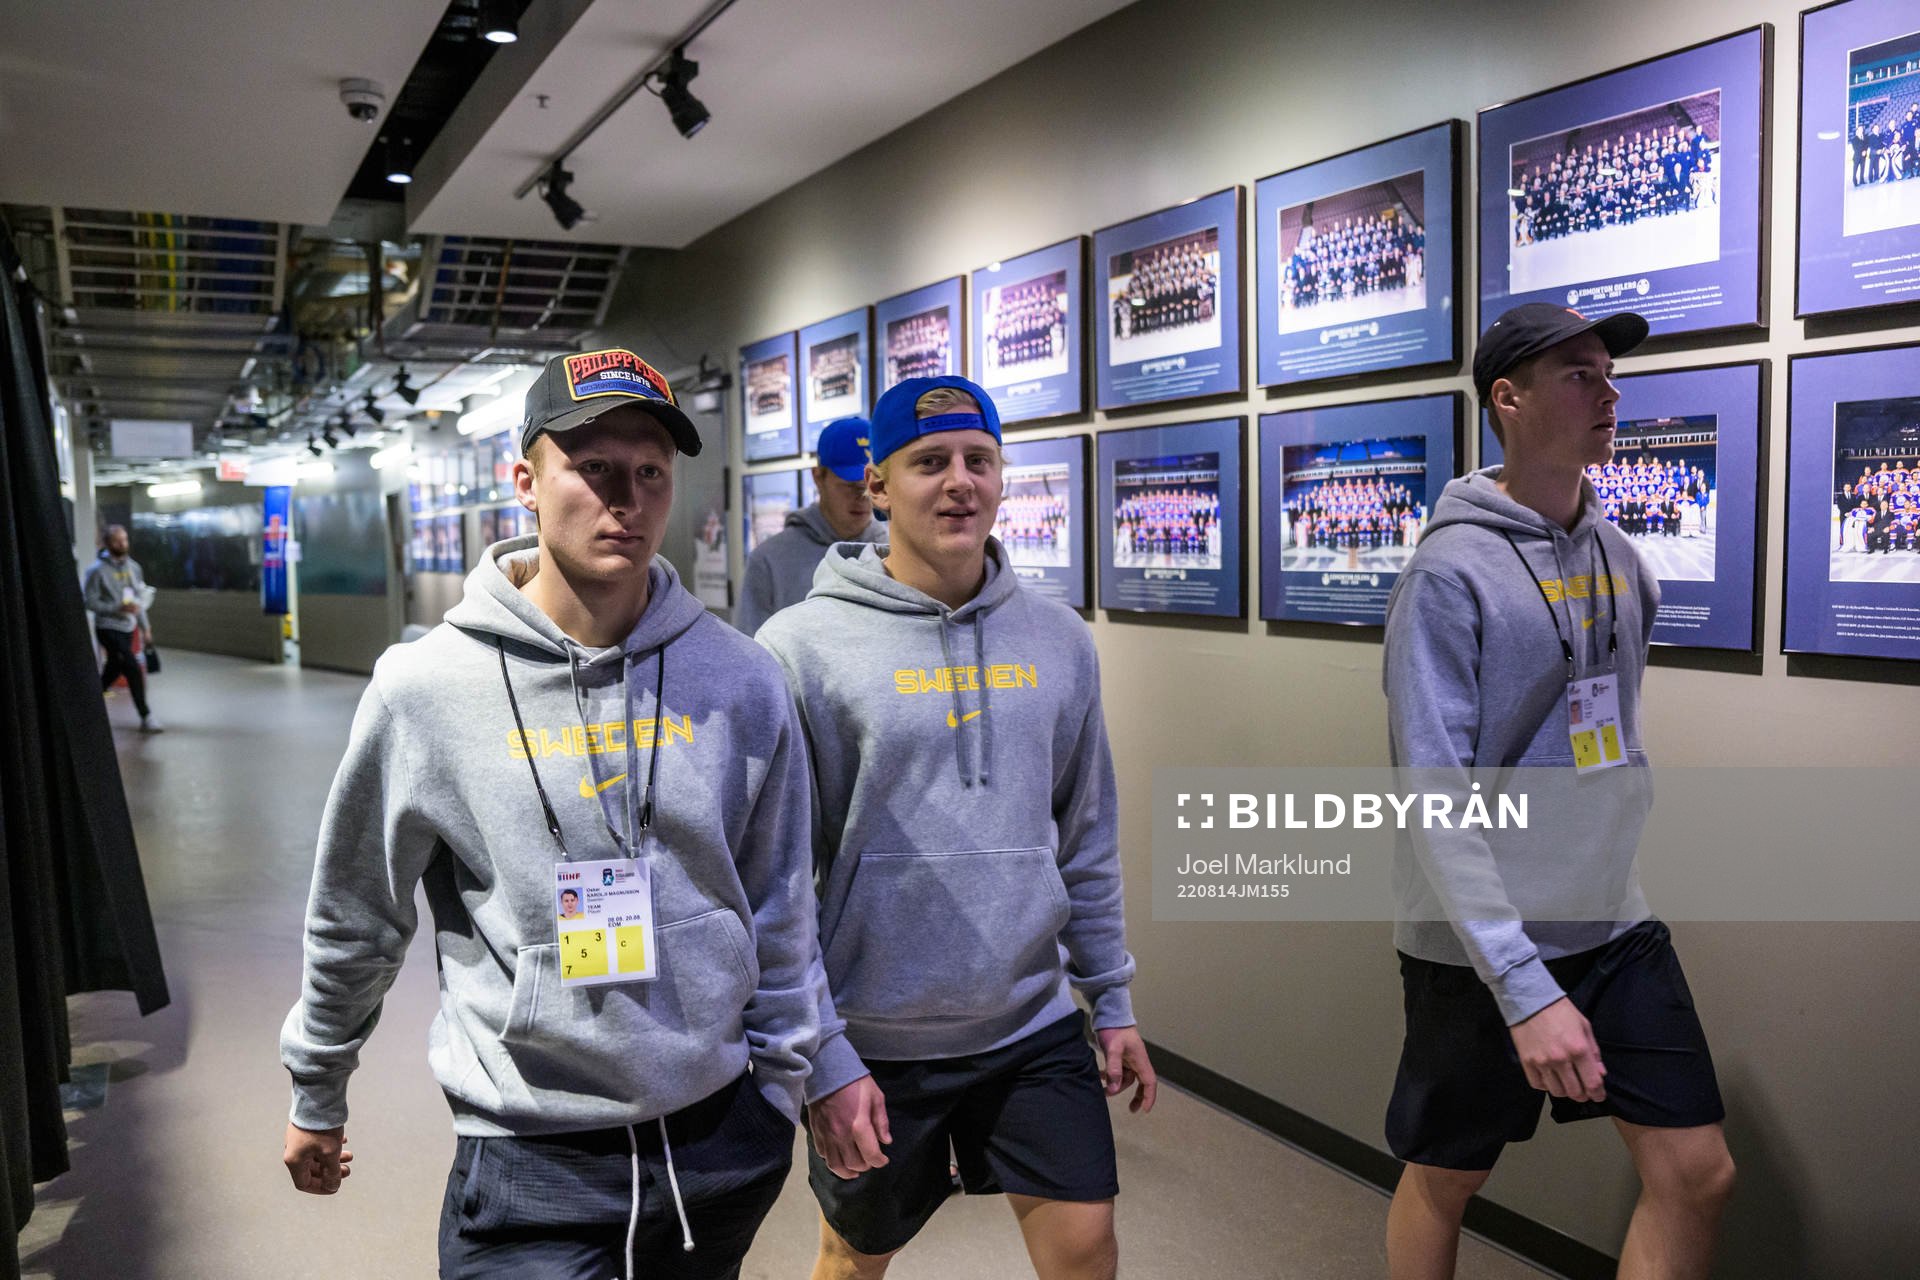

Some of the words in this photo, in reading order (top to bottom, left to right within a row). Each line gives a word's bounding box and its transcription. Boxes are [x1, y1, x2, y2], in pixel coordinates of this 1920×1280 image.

[569, 352, 633, 384] PHILIPP
[600, 371, 631, 380] SINCE
[894, 663, 1038, 694] SWEDEN
[507, 715, 694, 759] SWEDEN
[564, 935, 570, 944] 1
[595, 932, 602, 942] 3
[581, 948, 588, 958] 5
[566, 965, 573, 975] 7
